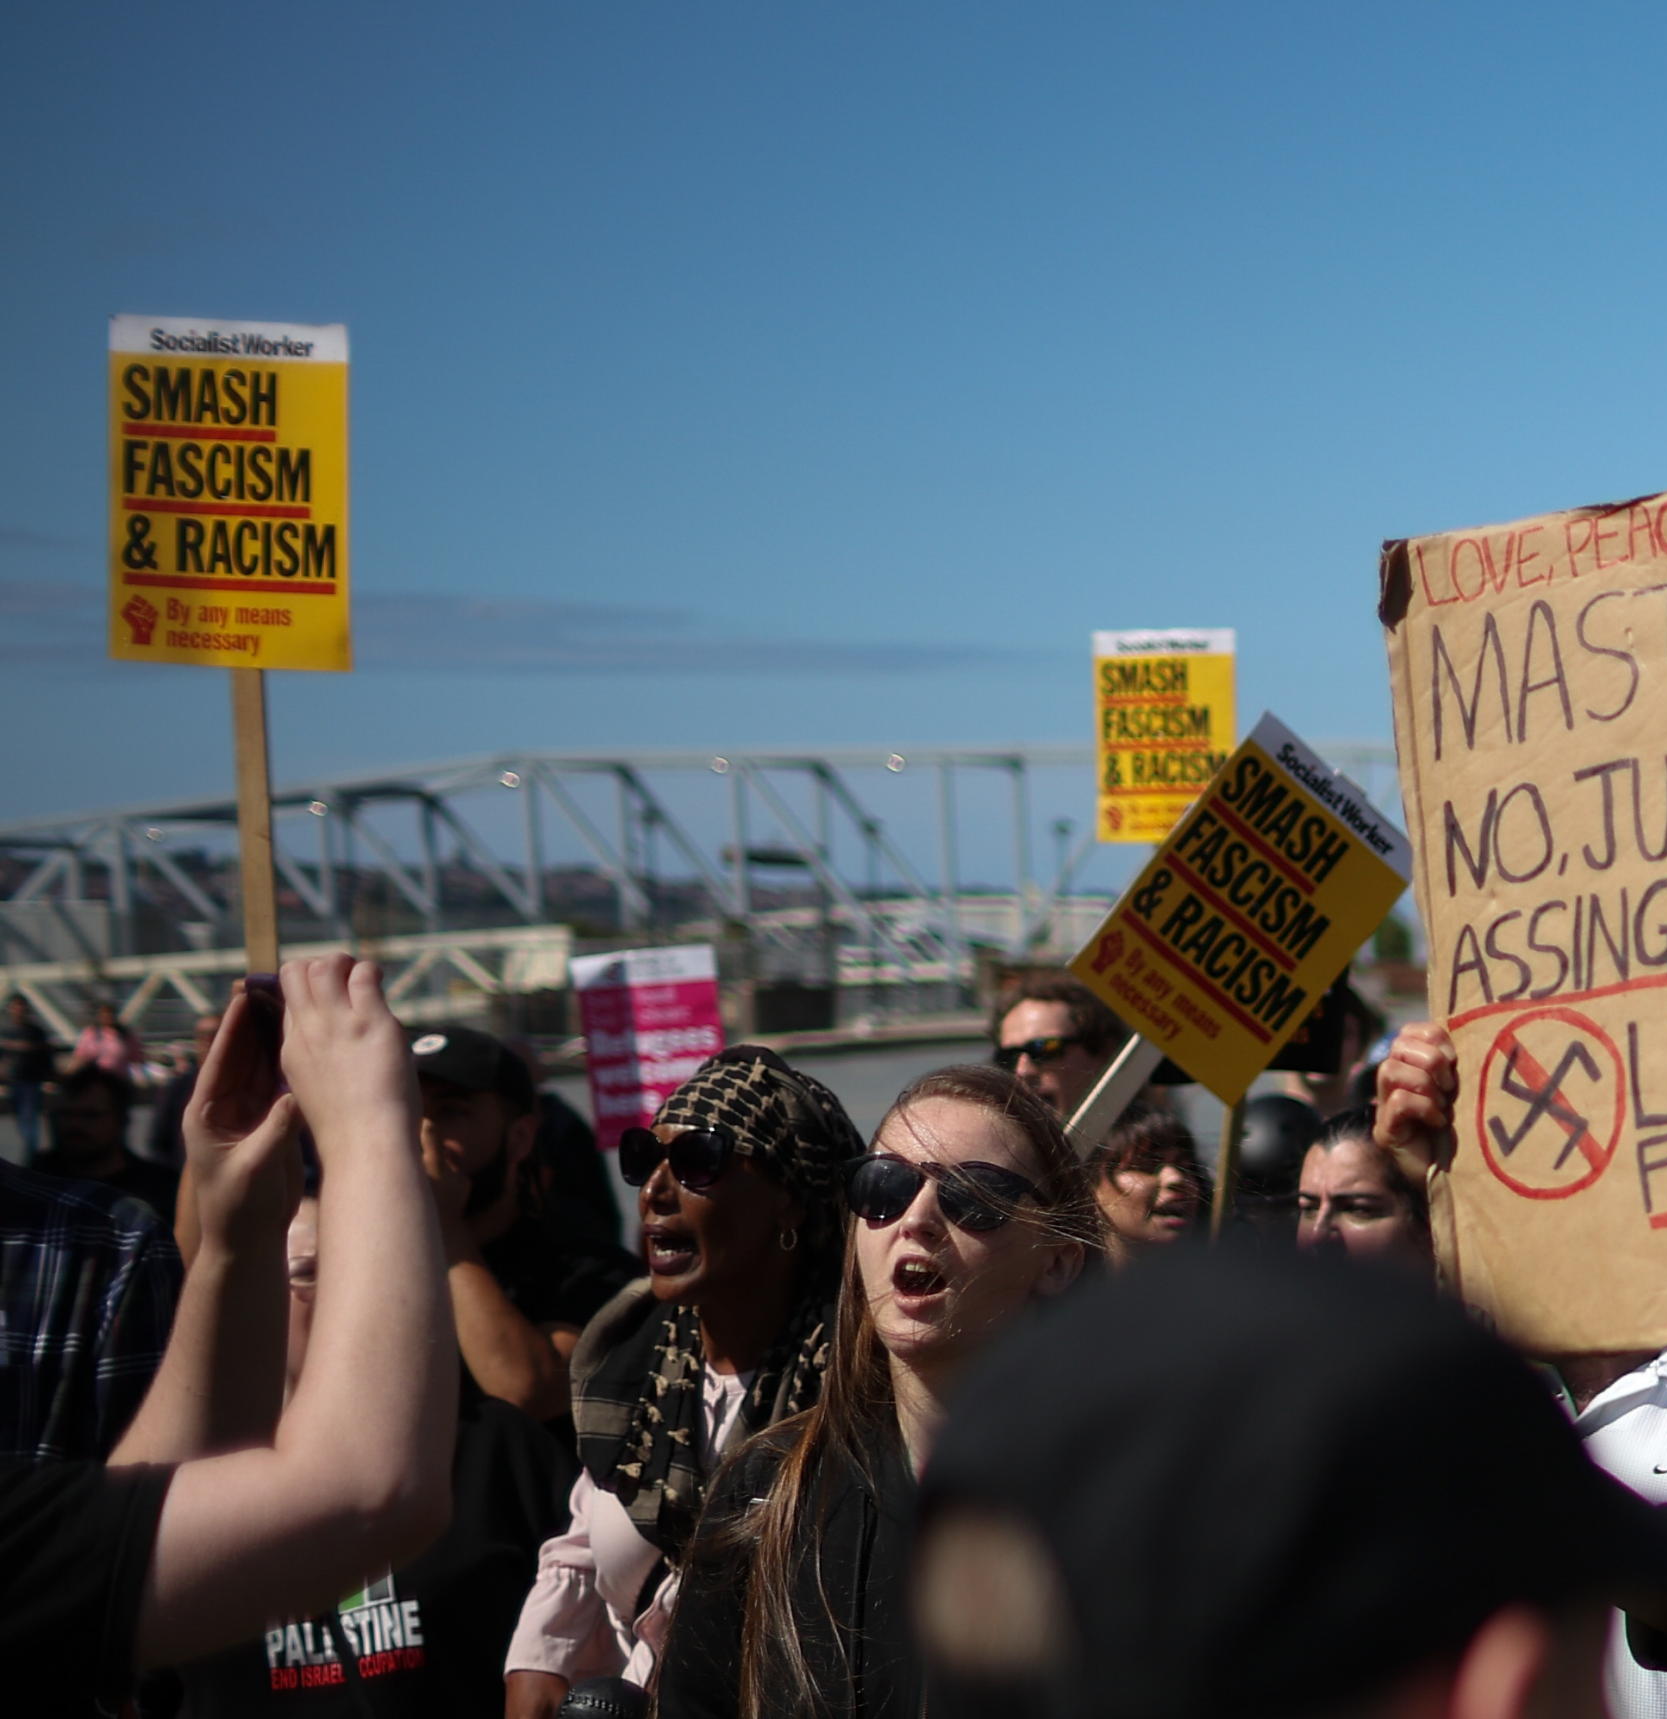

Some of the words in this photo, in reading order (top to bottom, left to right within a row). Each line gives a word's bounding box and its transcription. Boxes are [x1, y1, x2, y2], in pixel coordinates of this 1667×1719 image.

[151, 328, 239, 355] Socialist
[241, 333, 314, 358] Worker
[121, 362, 278, 426] SMASH
[121, 438, 312, 503] FASCISM
[121, 513, 158, 571] &
[175, 516, 336, 579] RACISM
[1416, 526, 1555, 607] LOVE,
[165, 596, 195, 624] By
[199, 604, 230, 627] any
[234, 604, 293, 627] means
[165, 629, 261, 657] necessary
[1101, 659, 1188, 695] SMASH
[1103, 704, 1210, 740] FASCISM
[1220, 755, 1350, 884] SMASH
[1276, 742, 1339, 809] Socialist
[1335, 799, 1395, 857] Worker
[1172, 809, 1332, 961] FASCISM
[1132, 867, 1173, 921] &
[1158, 892, 1308, 1033] RACISM
[270, 1666, 299, 1690] END
[301, 1662, 346, 1687] ISRAEL
